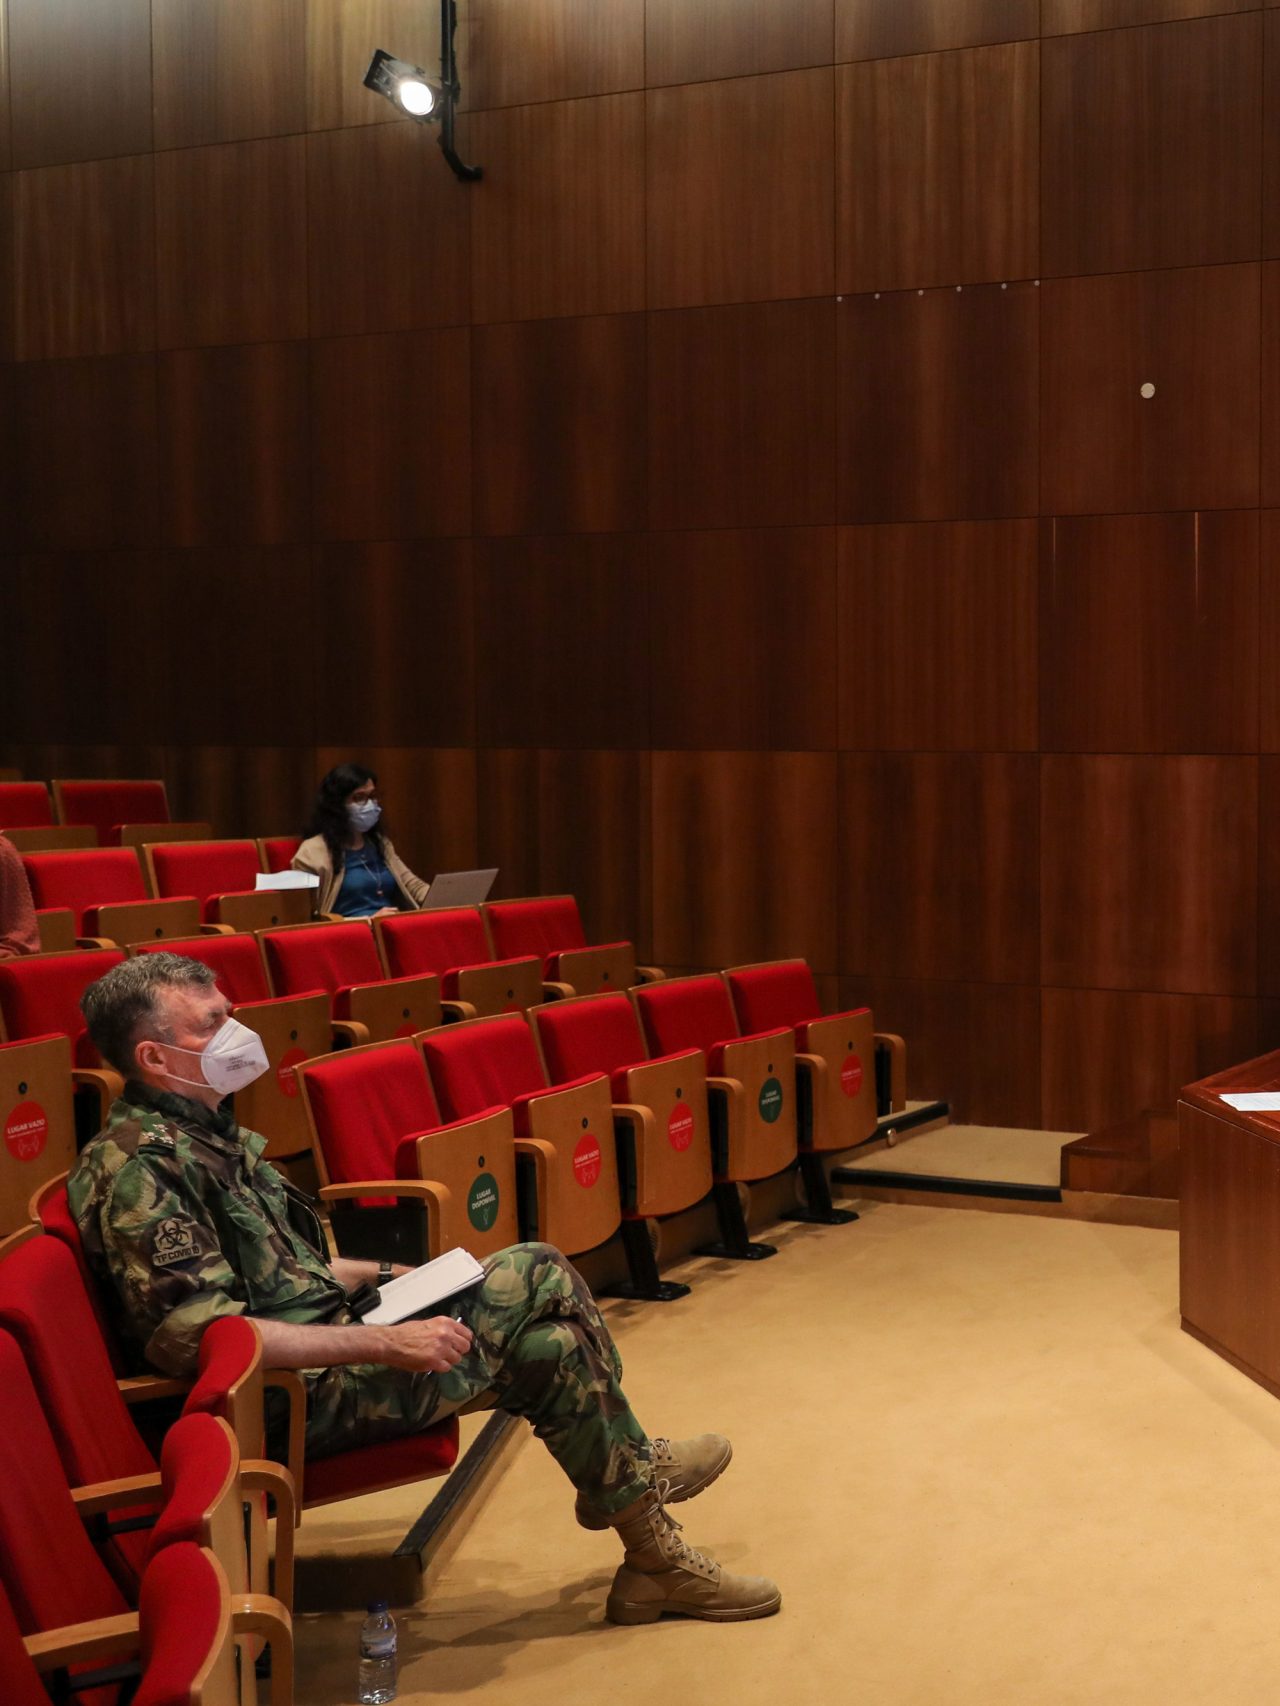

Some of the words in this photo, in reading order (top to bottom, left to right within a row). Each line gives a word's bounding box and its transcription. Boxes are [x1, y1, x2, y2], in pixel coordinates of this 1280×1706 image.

[7, 1123, 28, 1135] LUGAR
[476, 1188, 491, 1200] LUGAR
[155, 1254, 168, 1264] TF
[168, 1248, 191, 1260] COVID
